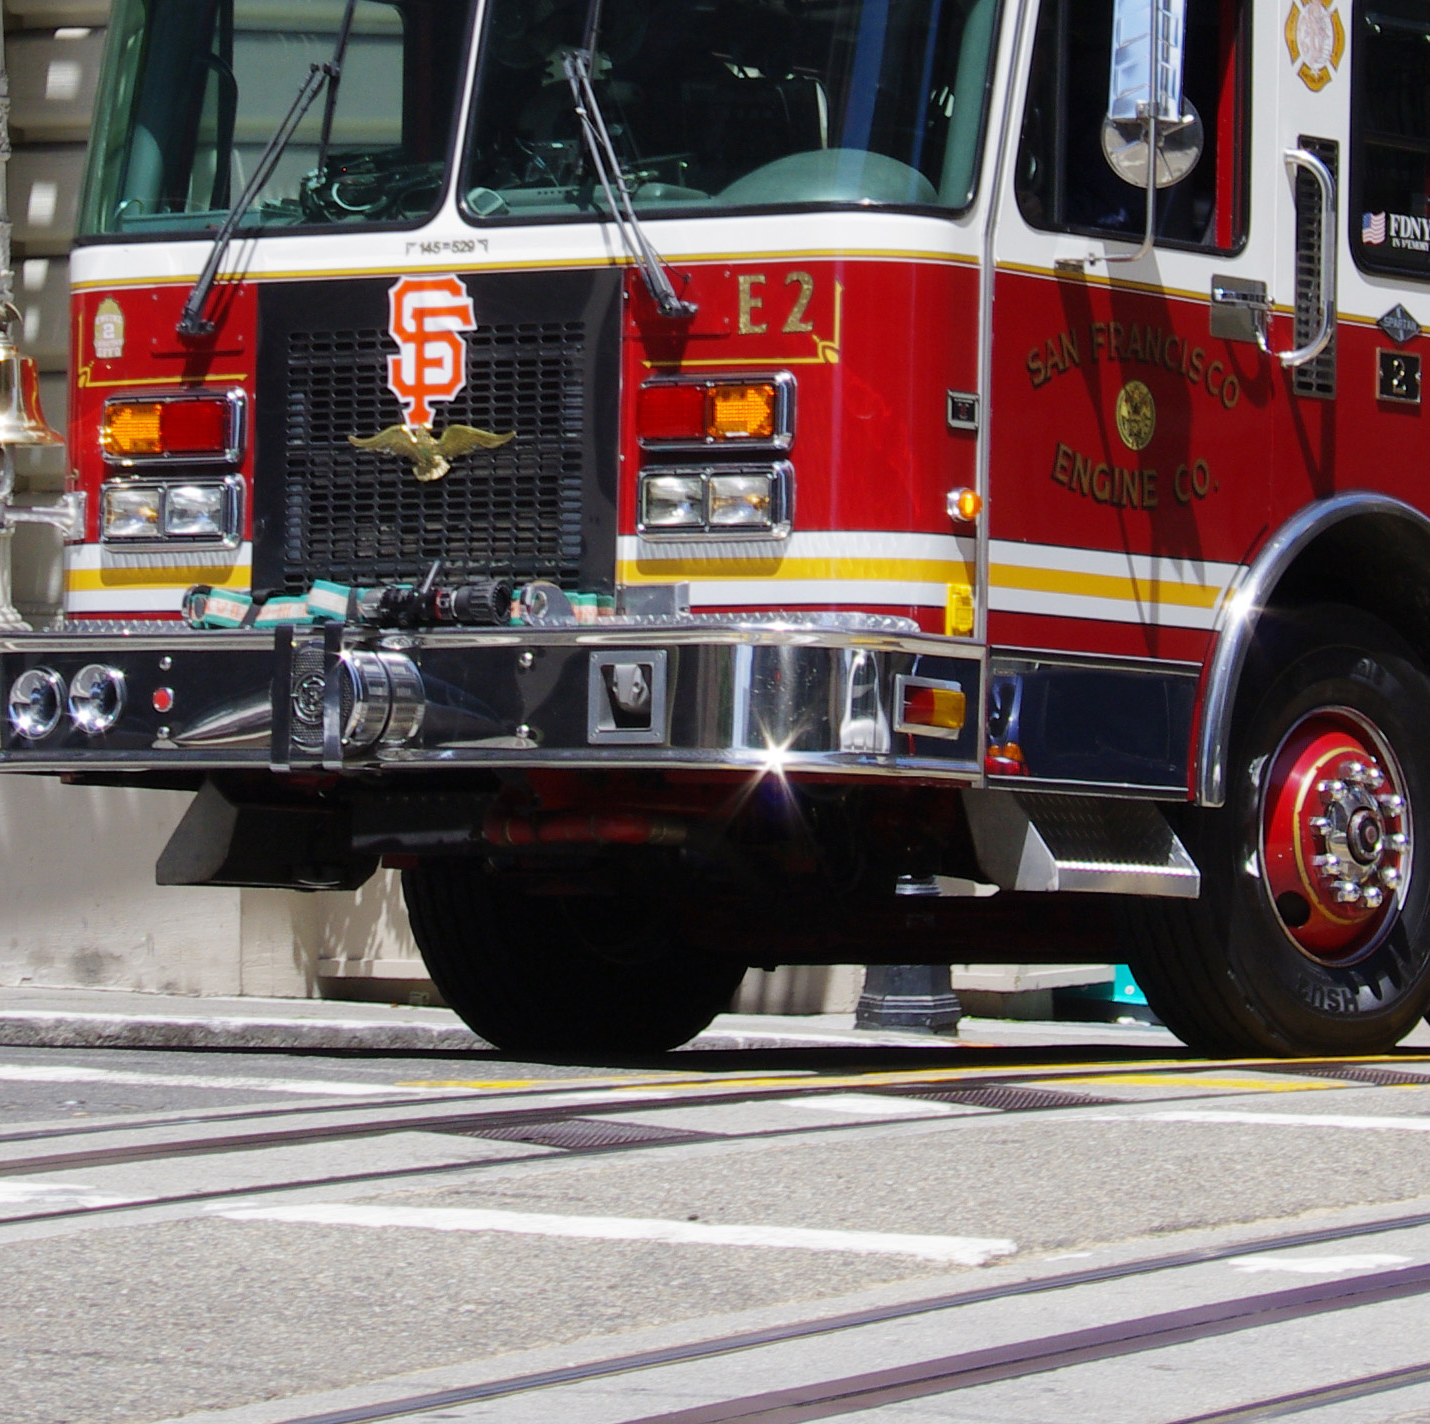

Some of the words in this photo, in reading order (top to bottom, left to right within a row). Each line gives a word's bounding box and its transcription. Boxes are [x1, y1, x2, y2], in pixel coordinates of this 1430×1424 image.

[1027, 328, 1080, 390] SAN
[1090, 321, 1240, 409] FRANCISCO
[1051, 441, 1159, 510] ENGINE
[1174, 457, 1219, 505] CO.
